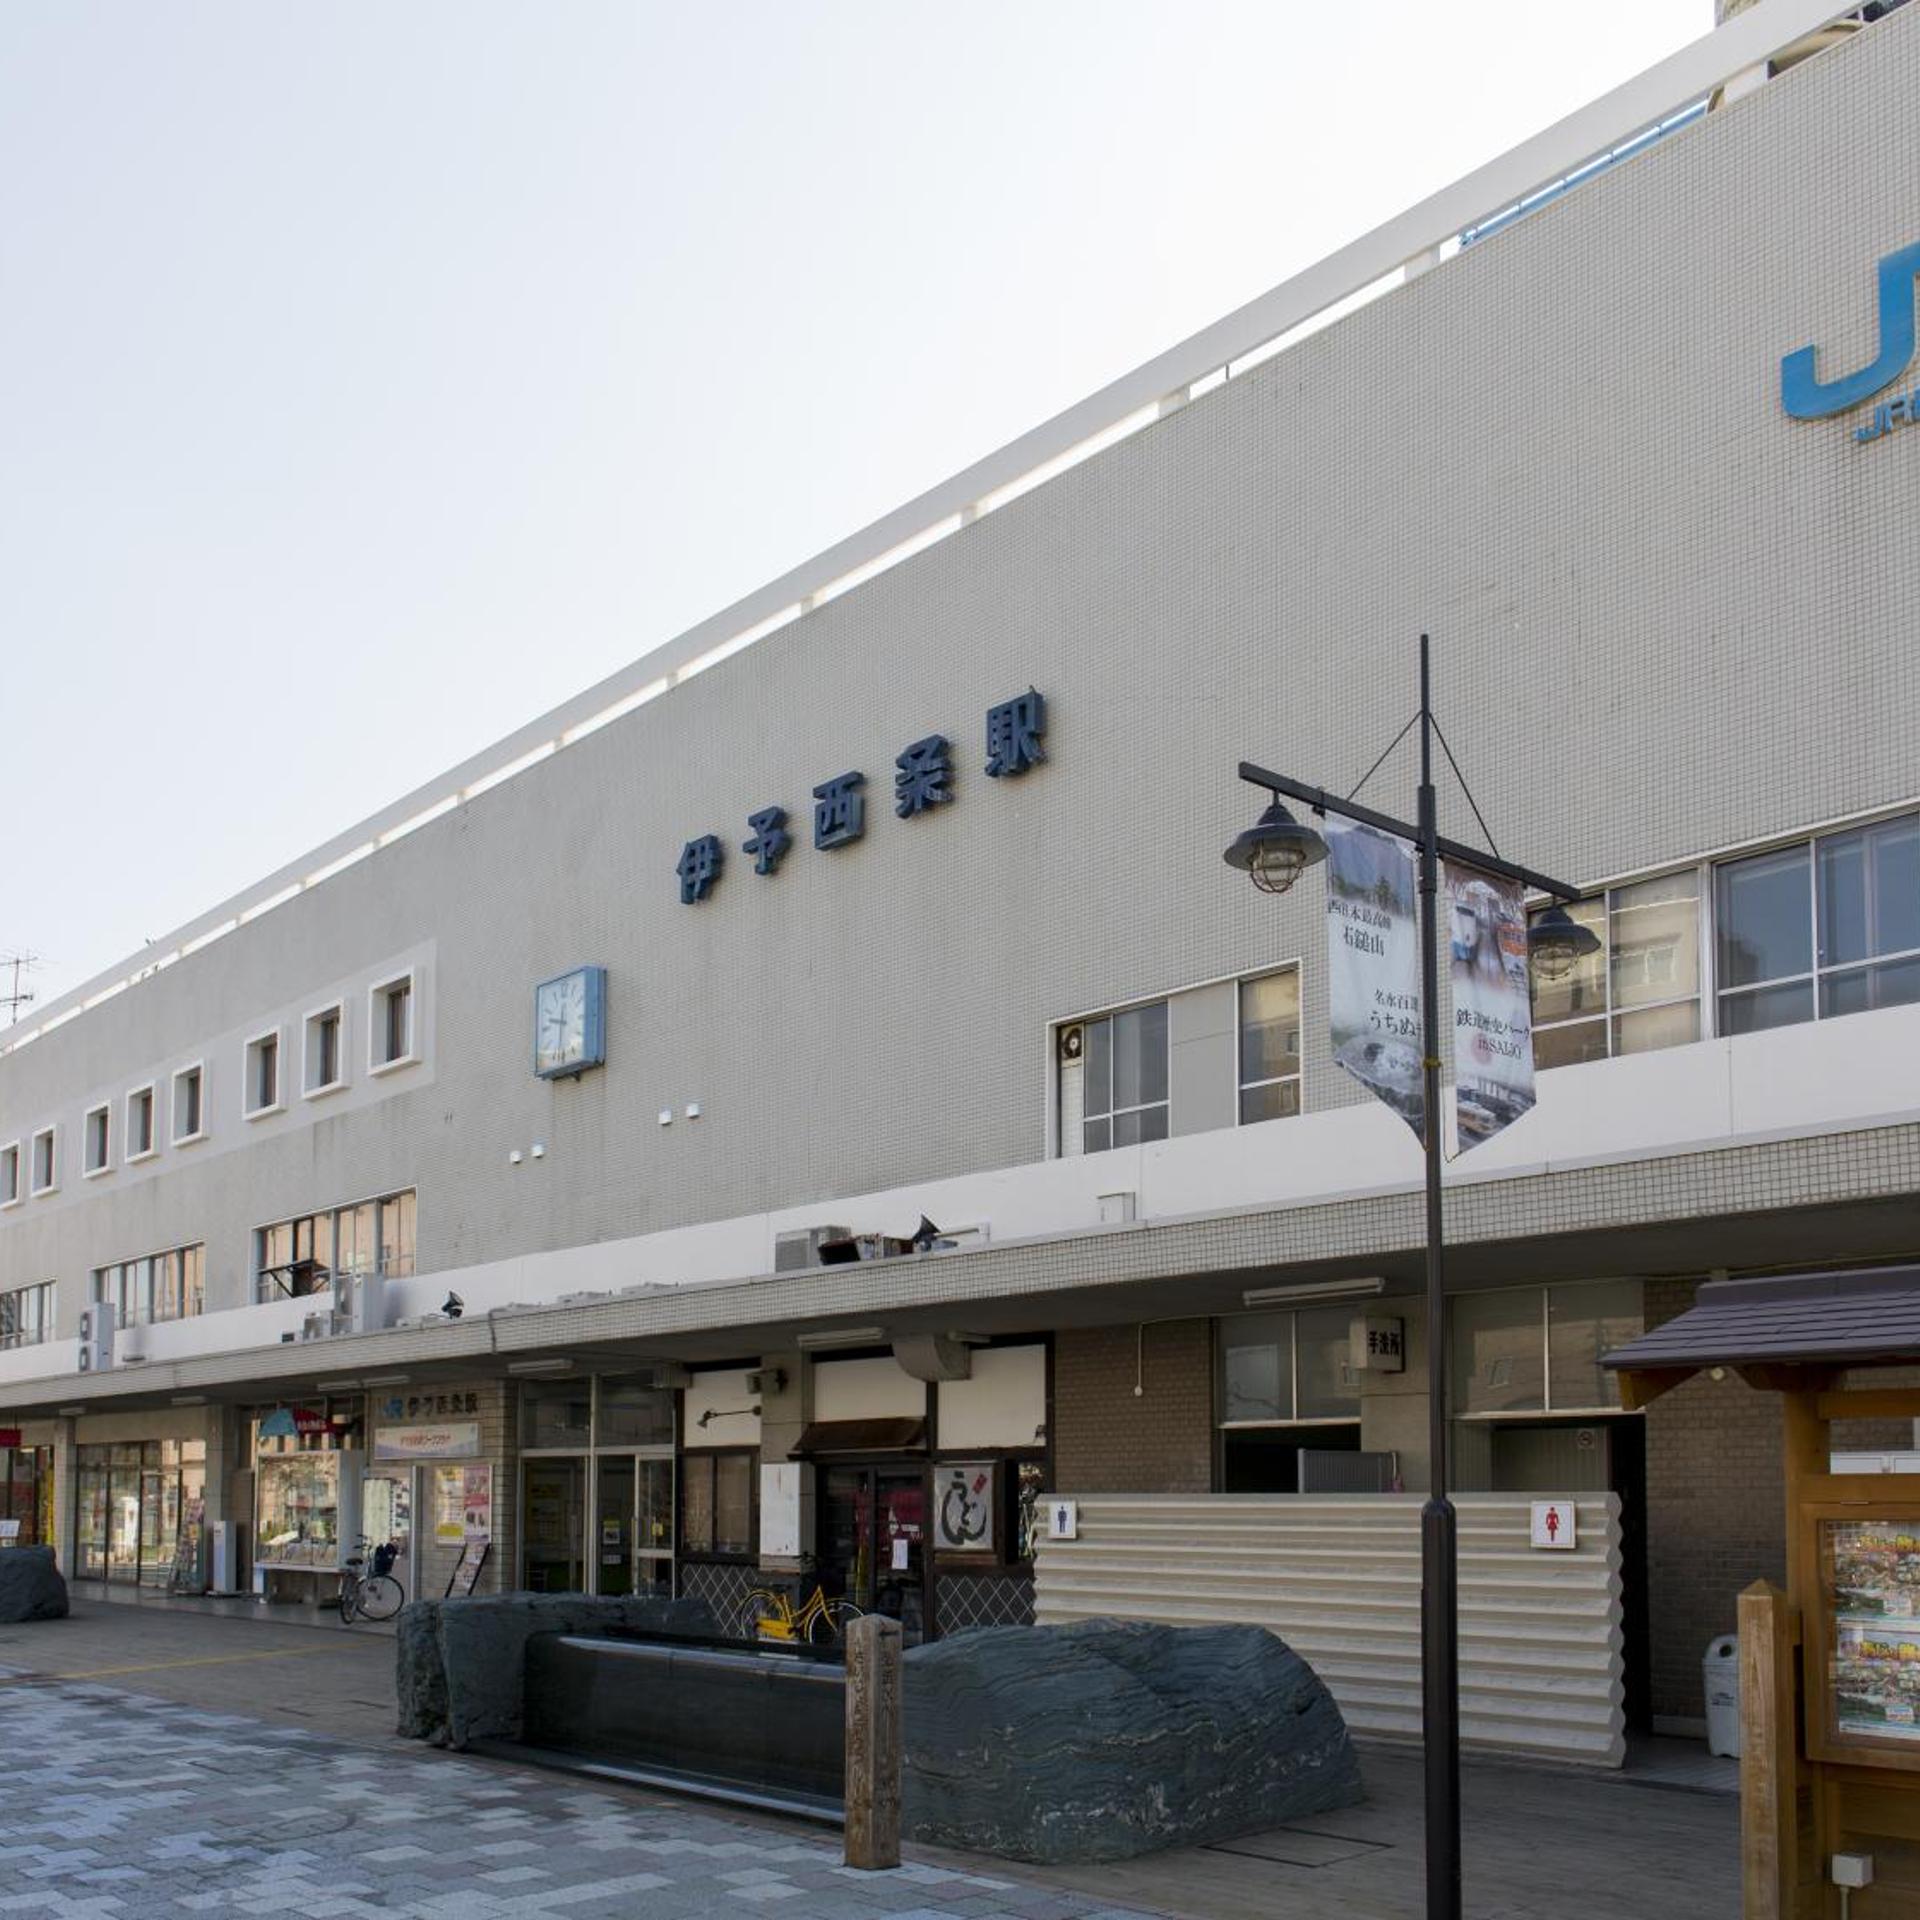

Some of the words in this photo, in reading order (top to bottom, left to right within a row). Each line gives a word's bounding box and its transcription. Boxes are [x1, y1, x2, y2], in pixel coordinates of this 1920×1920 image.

[1781, 240, 1920, 421] J
[1856, 388, 1920, 443] JR
[676, 685, 1046, 905] 伊予西条駅
